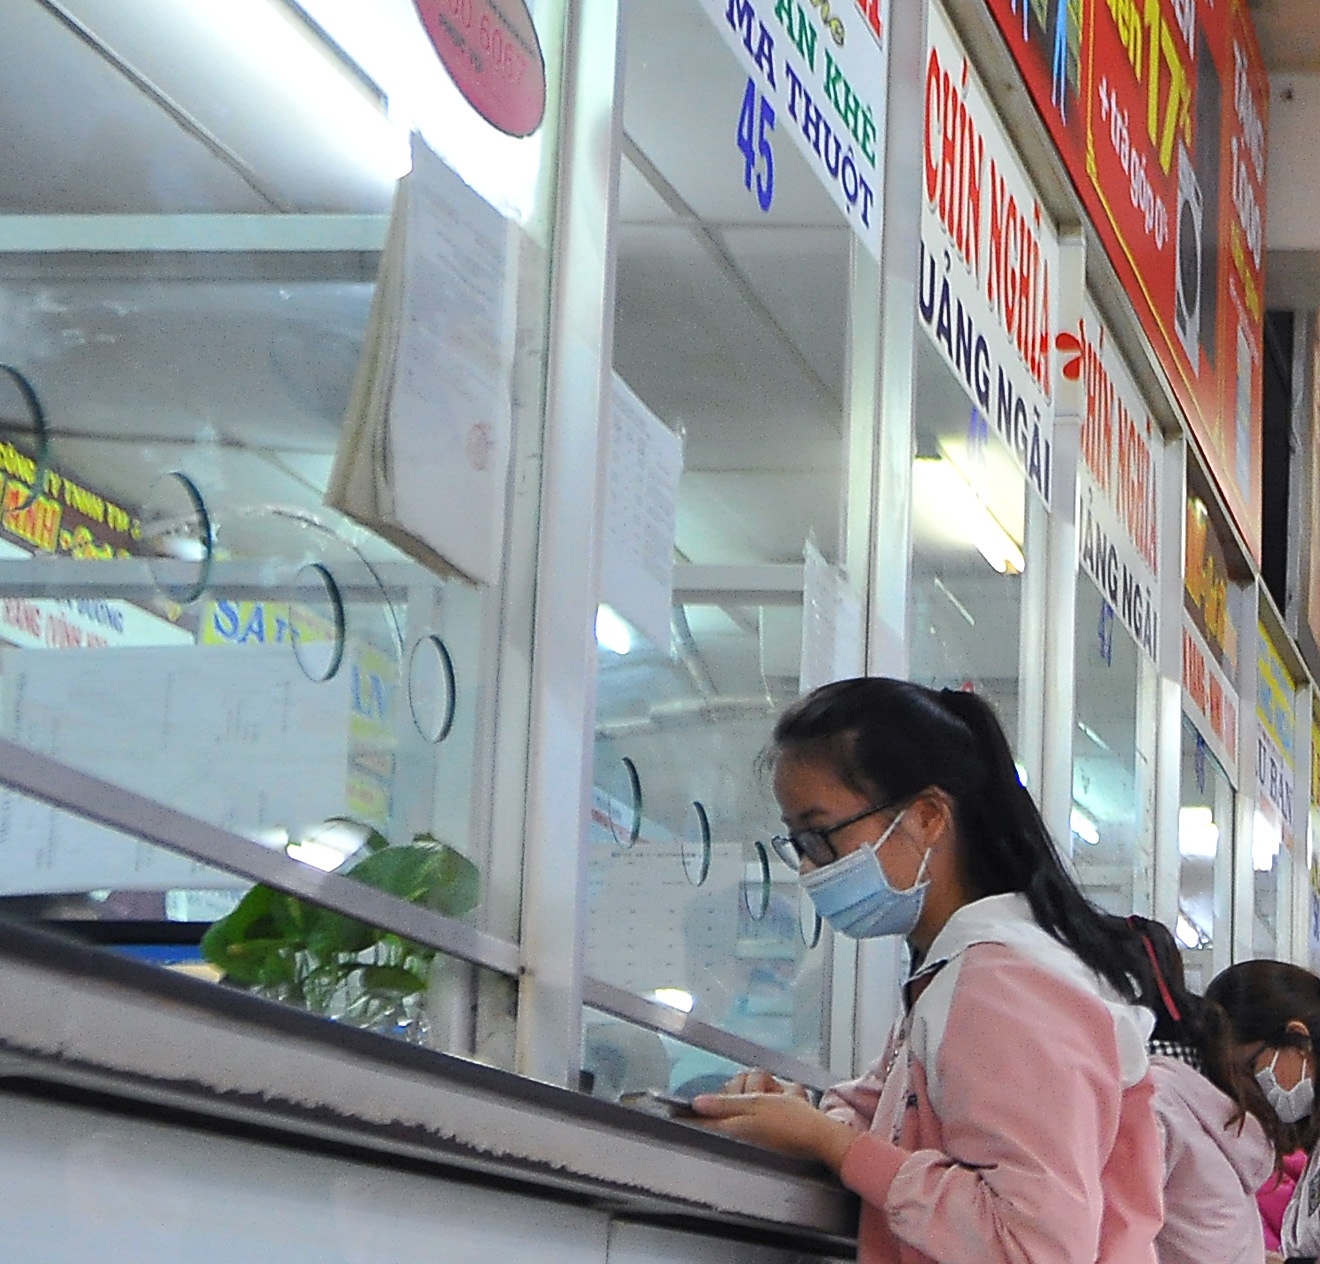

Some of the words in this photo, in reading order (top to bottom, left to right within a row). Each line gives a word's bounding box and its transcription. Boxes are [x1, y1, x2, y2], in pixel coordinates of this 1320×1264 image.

[736, 76, 775, 213] 45
[785, 60, 874, 229] THUỘT
[923, 46, 985, 278] CHÍN
[986, 157, 1051, 400] NGHĨA
[919, 240, 991, 414] UẢNG
[997, 363, 1051, 506] NGÃI
[1122, 562, 1158, 664] NGÃI
